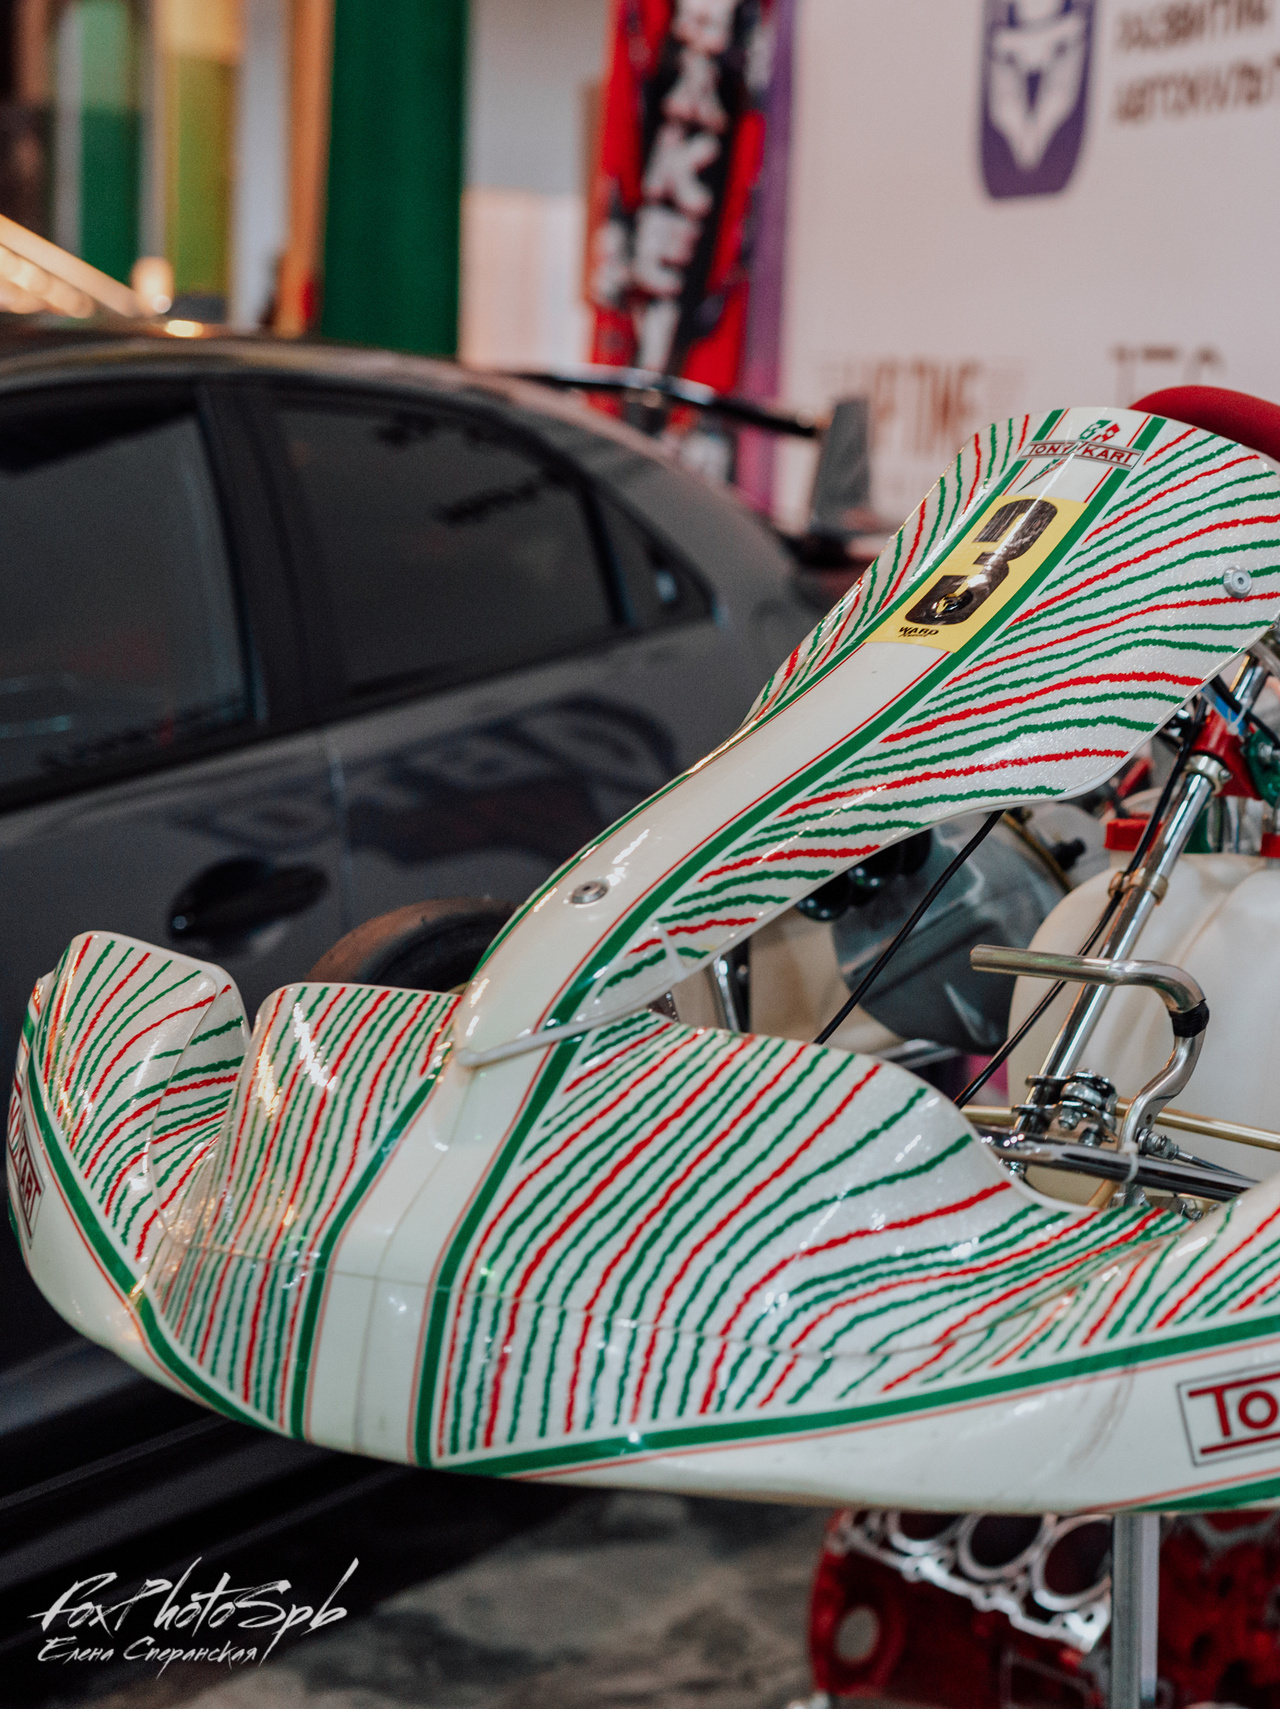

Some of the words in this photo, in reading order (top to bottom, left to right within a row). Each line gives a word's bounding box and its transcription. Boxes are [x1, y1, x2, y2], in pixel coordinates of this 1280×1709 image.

[1029, 441, 1076, 456] TONY
[1081, 443, 1141, 464] KART
[904, 498, 1059, 626] 3
